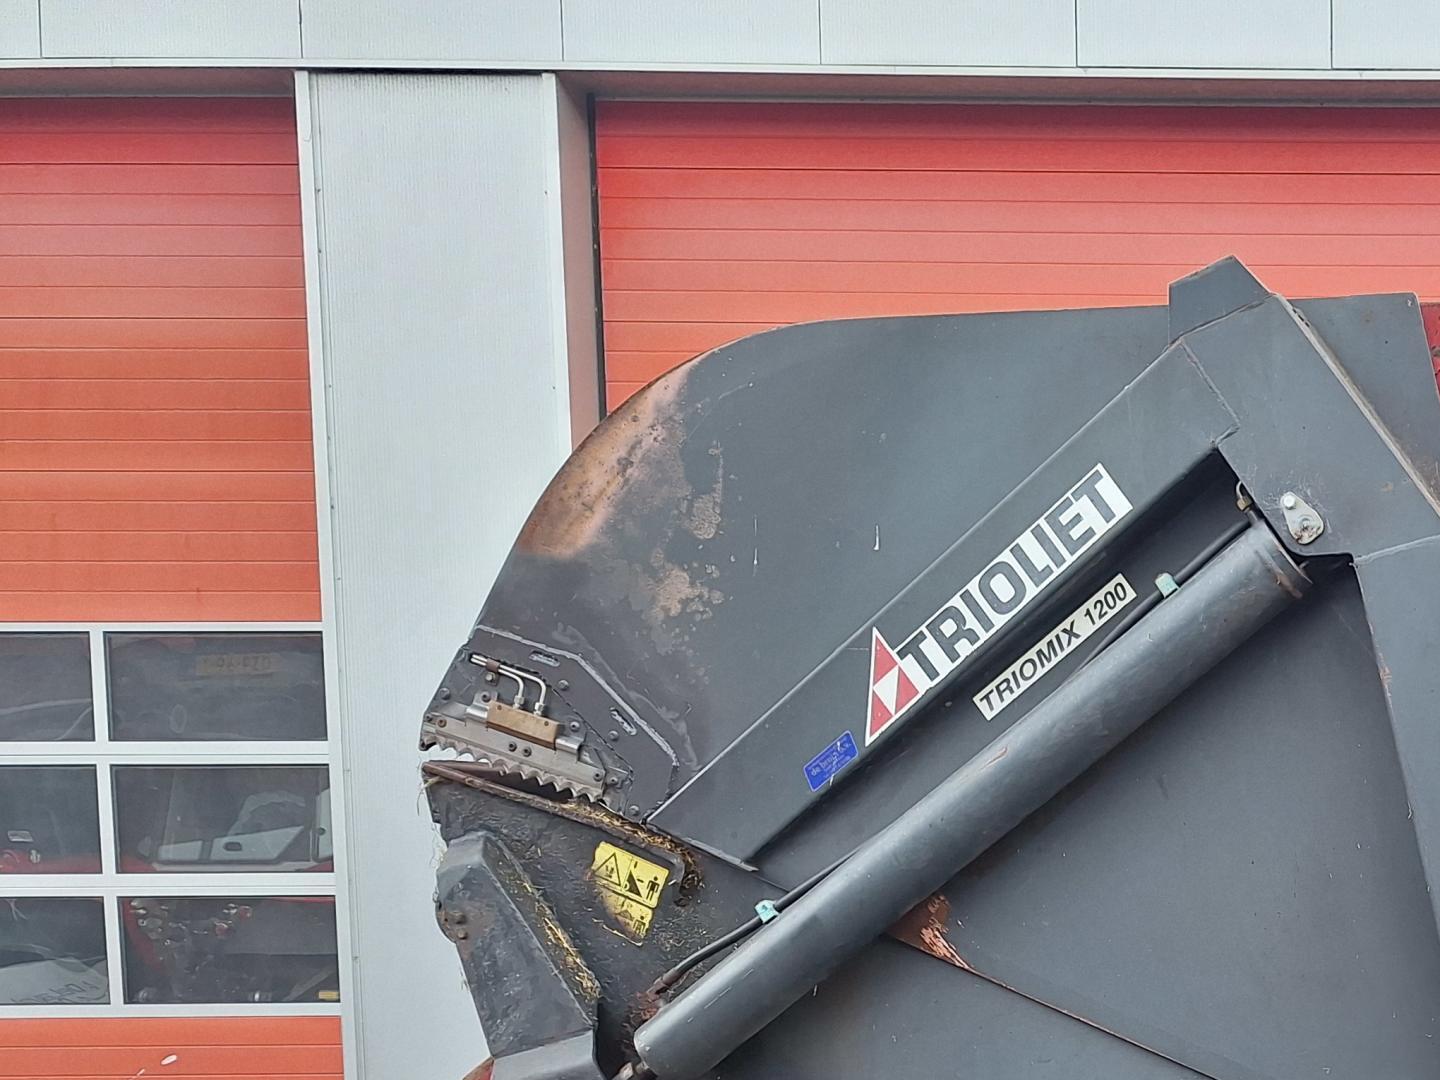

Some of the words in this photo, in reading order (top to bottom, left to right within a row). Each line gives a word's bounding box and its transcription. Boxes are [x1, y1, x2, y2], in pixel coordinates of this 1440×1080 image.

[895, 468, 1117, 682] TRIOLIET
[979, 619, 1082, 713] TRIOMIX
[1083, 581, 1127, 626] 1200
